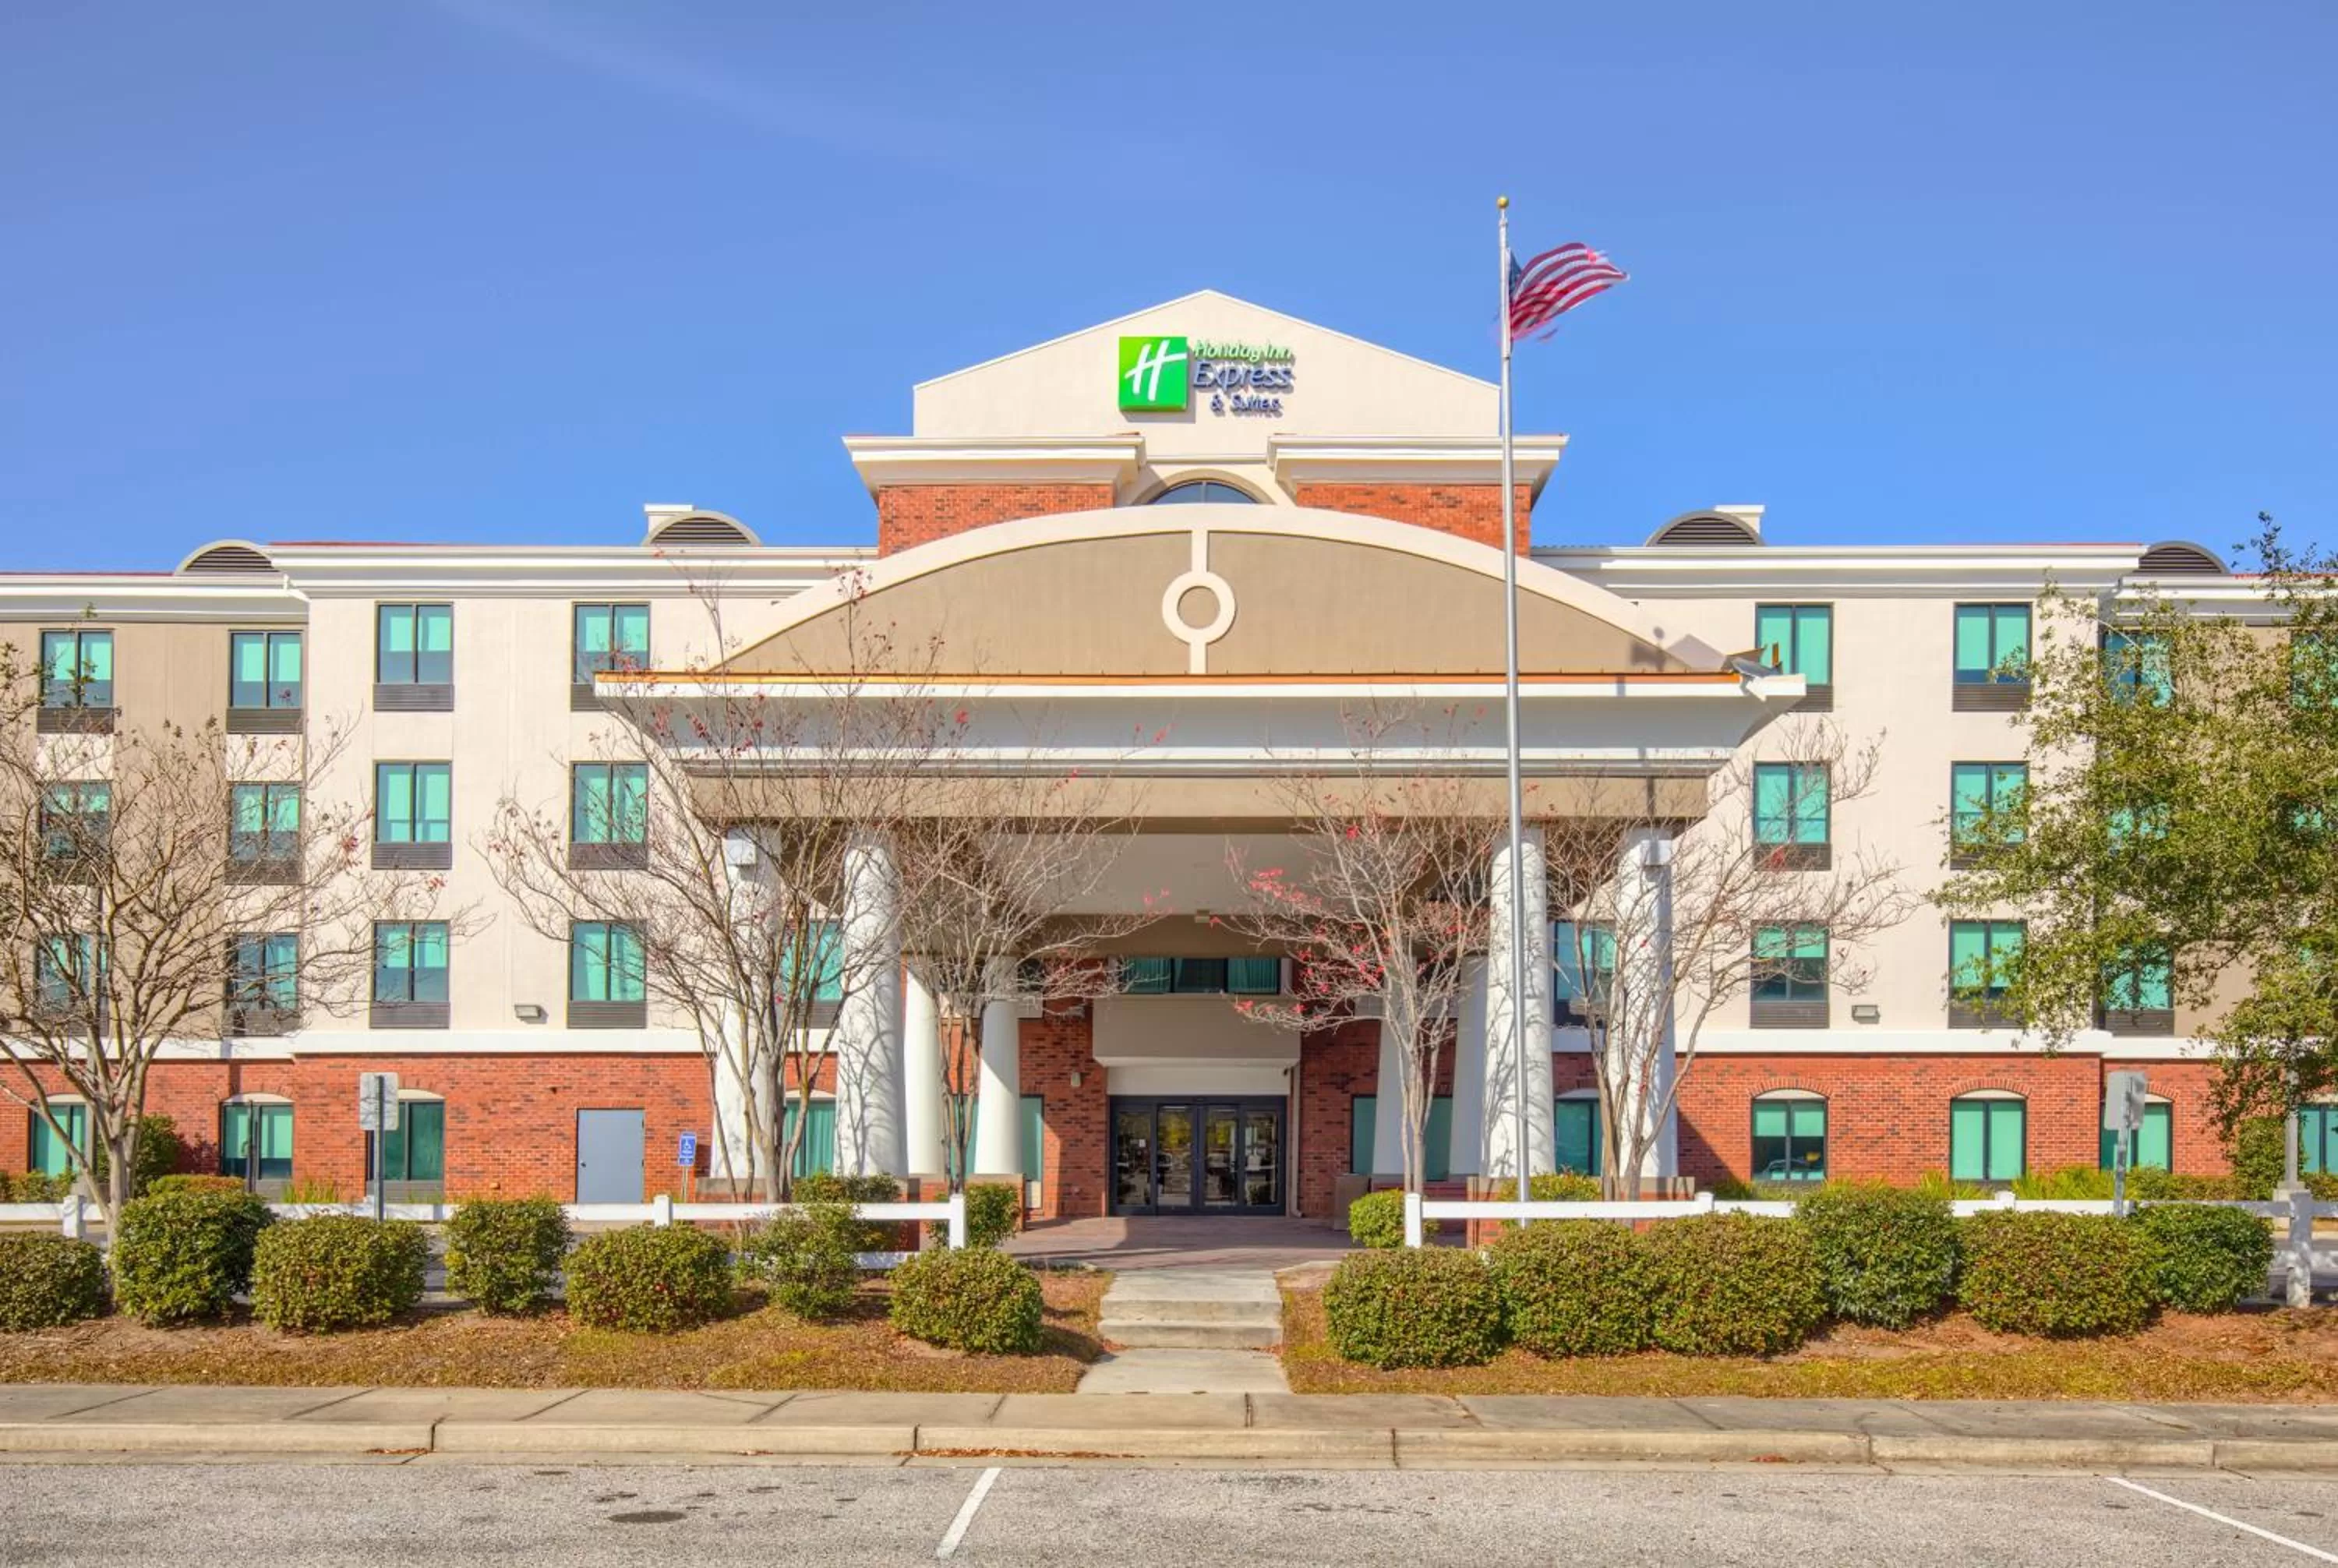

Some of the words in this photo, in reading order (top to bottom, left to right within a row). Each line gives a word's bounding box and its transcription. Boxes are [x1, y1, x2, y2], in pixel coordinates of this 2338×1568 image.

[1194, 341, 1261, 362] Holiday
[1263, 342, 1293, 359] Inn
[1193, 359, 1294, 390] Express
[1210, 393, 1224, 411] &
[1230, 393, 1282, 411] Suites
